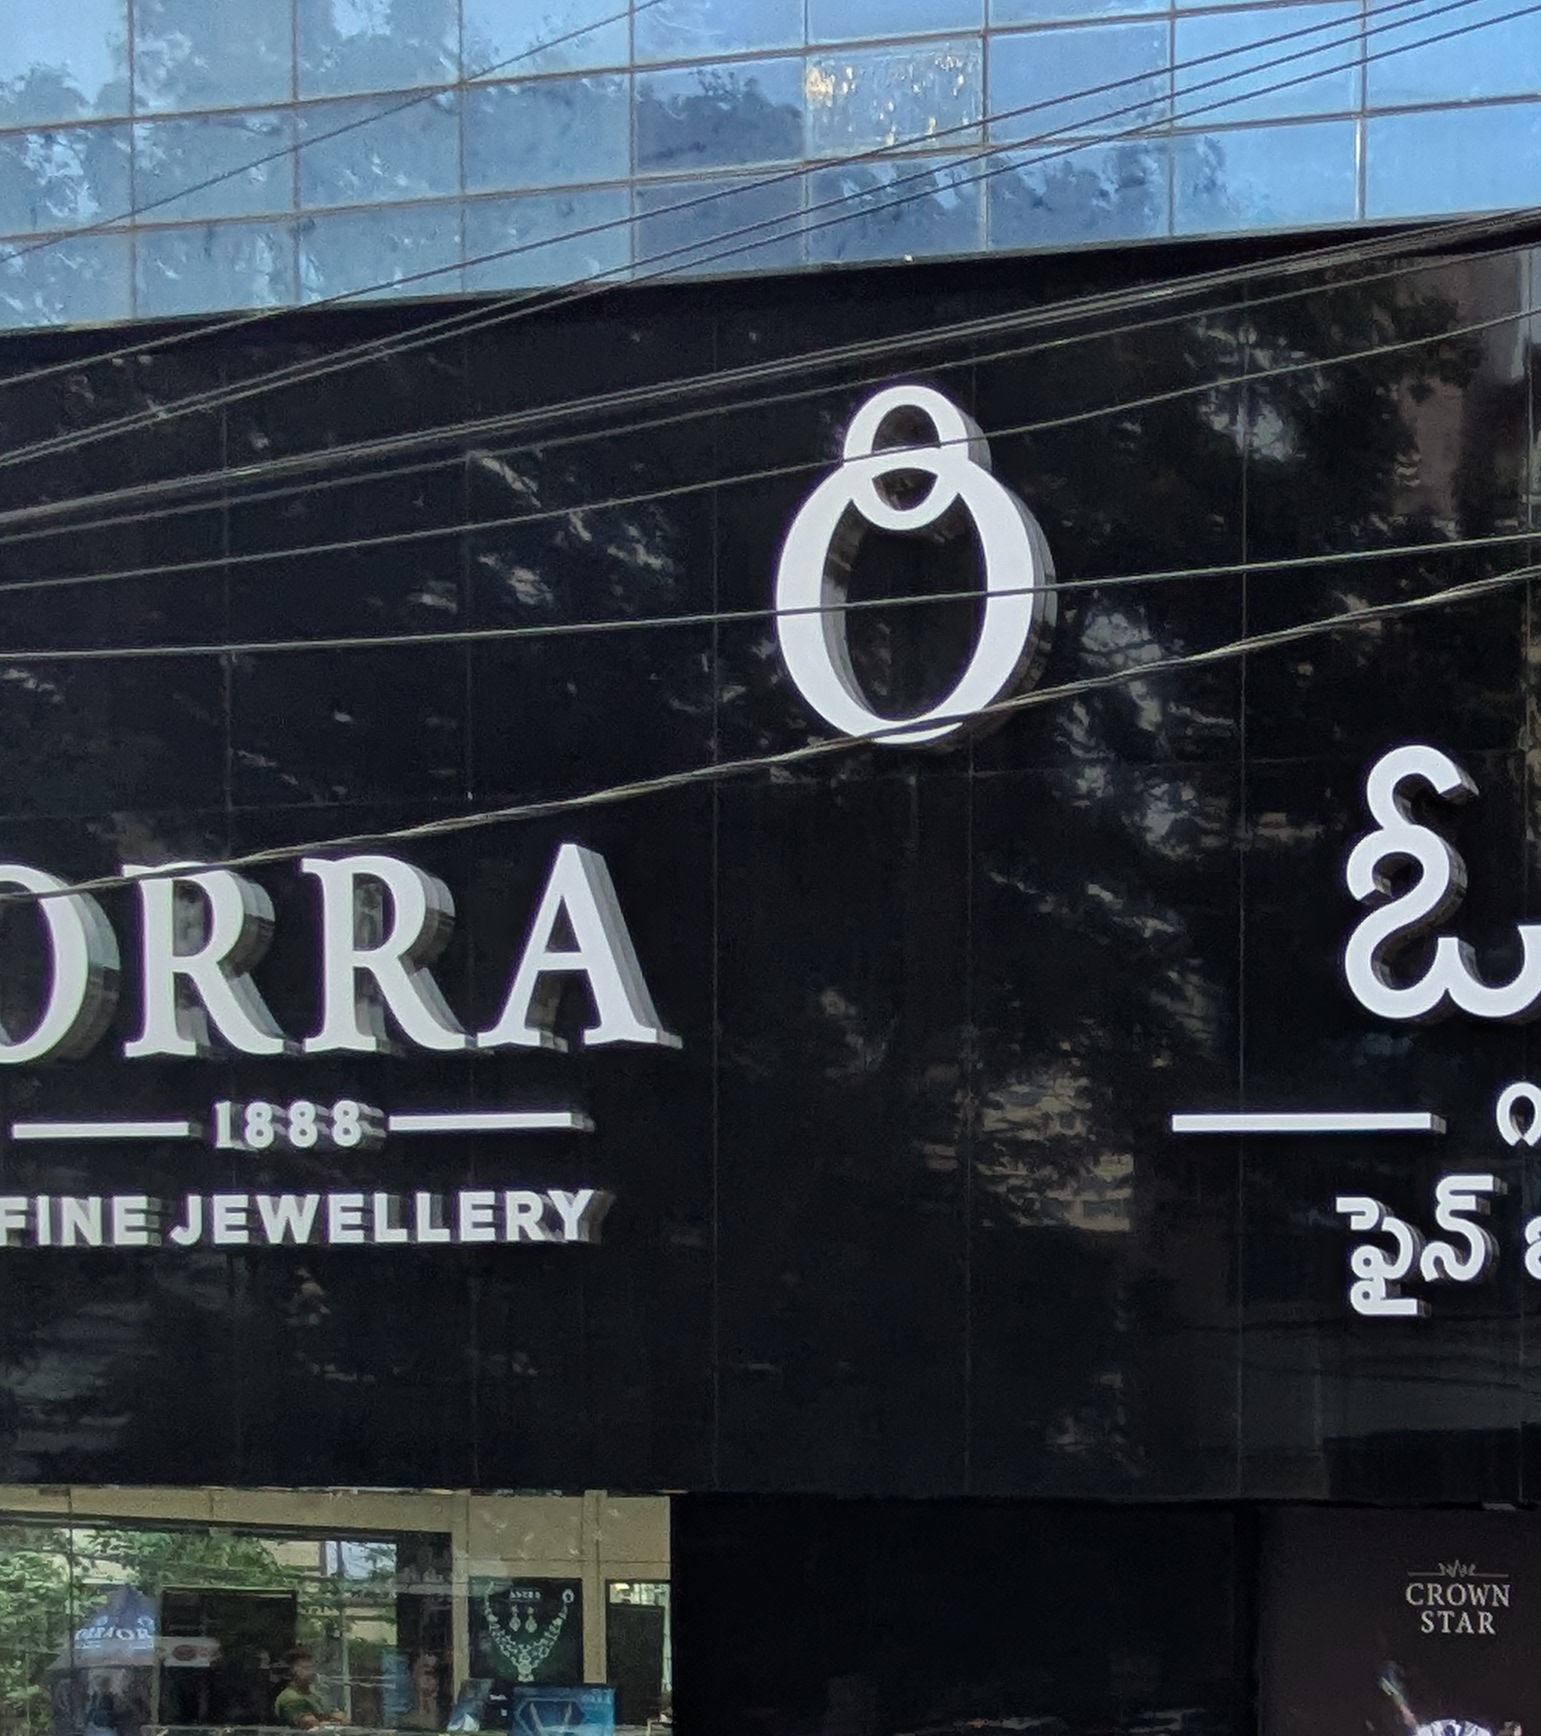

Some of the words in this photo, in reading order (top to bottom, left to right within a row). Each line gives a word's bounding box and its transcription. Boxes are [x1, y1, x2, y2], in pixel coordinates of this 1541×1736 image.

[213, 1100, 372, 1149] 1888
[0, 1195, 156, 1246] FINE
[170, 1188, 600, 1246] JEWELLERY
[1405, 1582, 1511, 1607] CROWN
[1420, 1610, 1497, 1635] STAR
